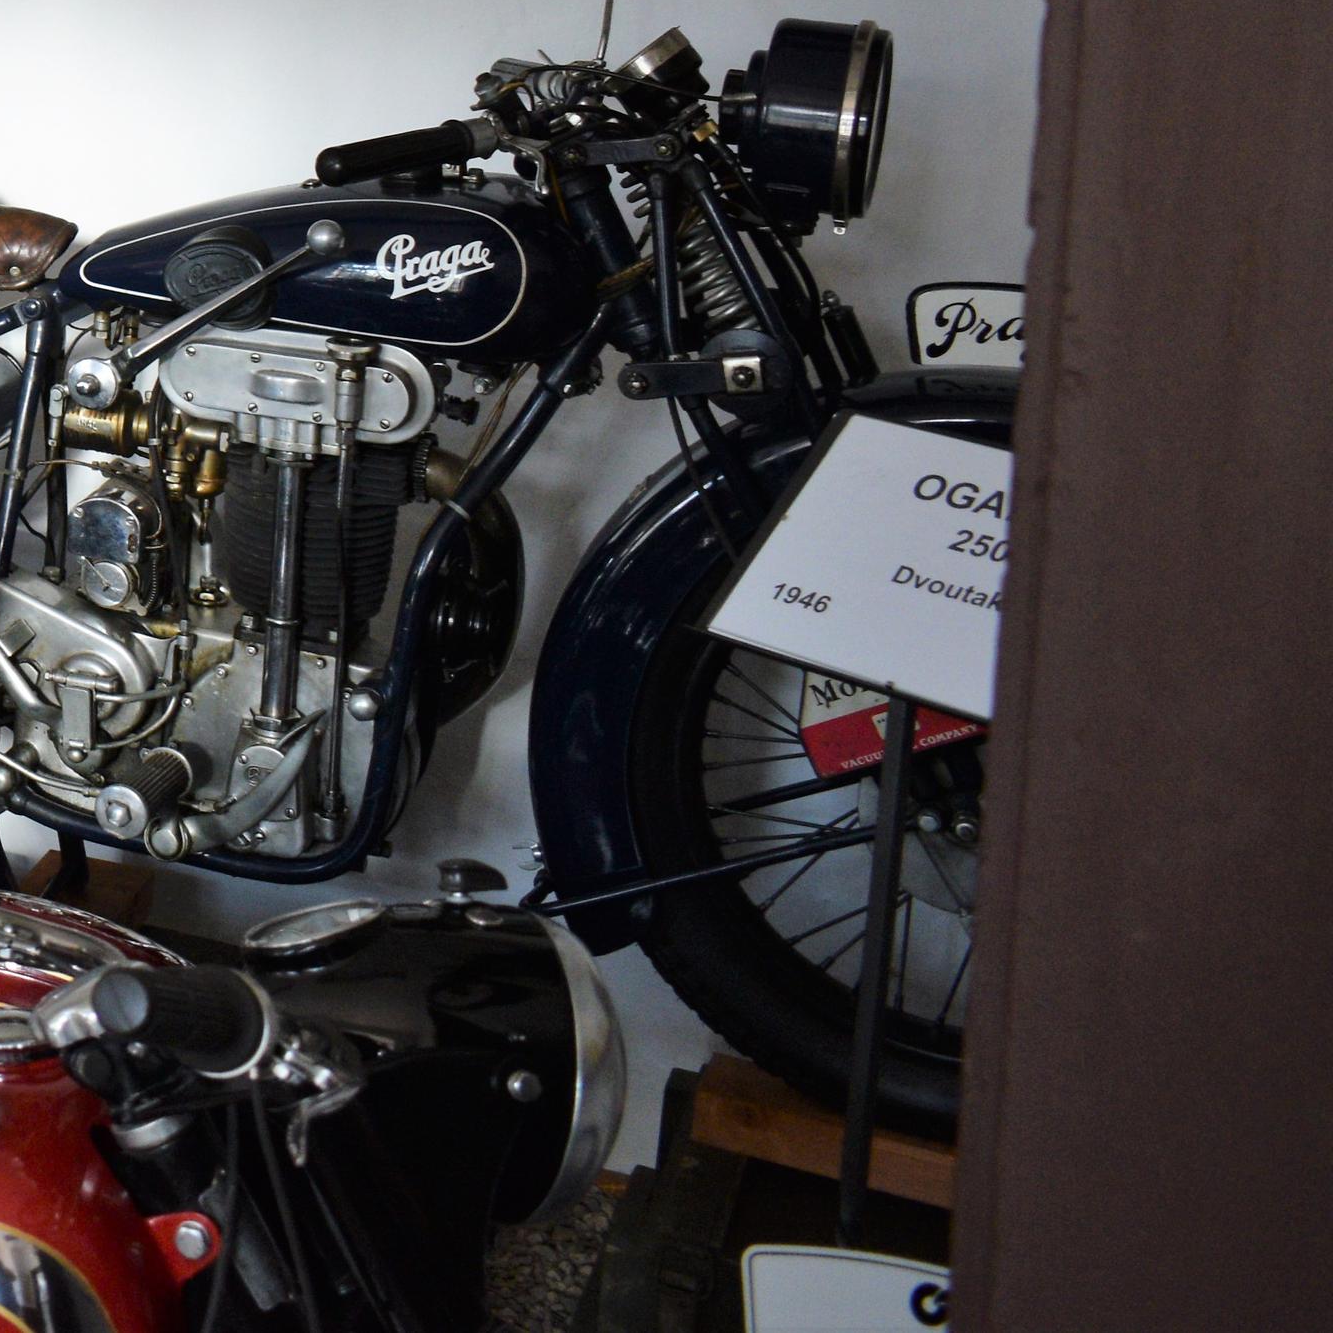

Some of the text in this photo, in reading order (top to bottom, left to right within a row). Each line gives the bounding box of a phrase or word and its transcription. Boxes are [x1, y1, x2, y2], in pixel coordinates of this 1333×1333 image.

[375, 233, 496, 300] Praga
[925, 297, 1026, 362] Pra
[912, 474, 1010, 521] OGA
[947, 529, 1012, 563] 250
[772, 582, 832, 614] 1946
[890, 564, 1003, 612] Dvoutak
[840, 723, 978, 770] VACUU COMPANY
